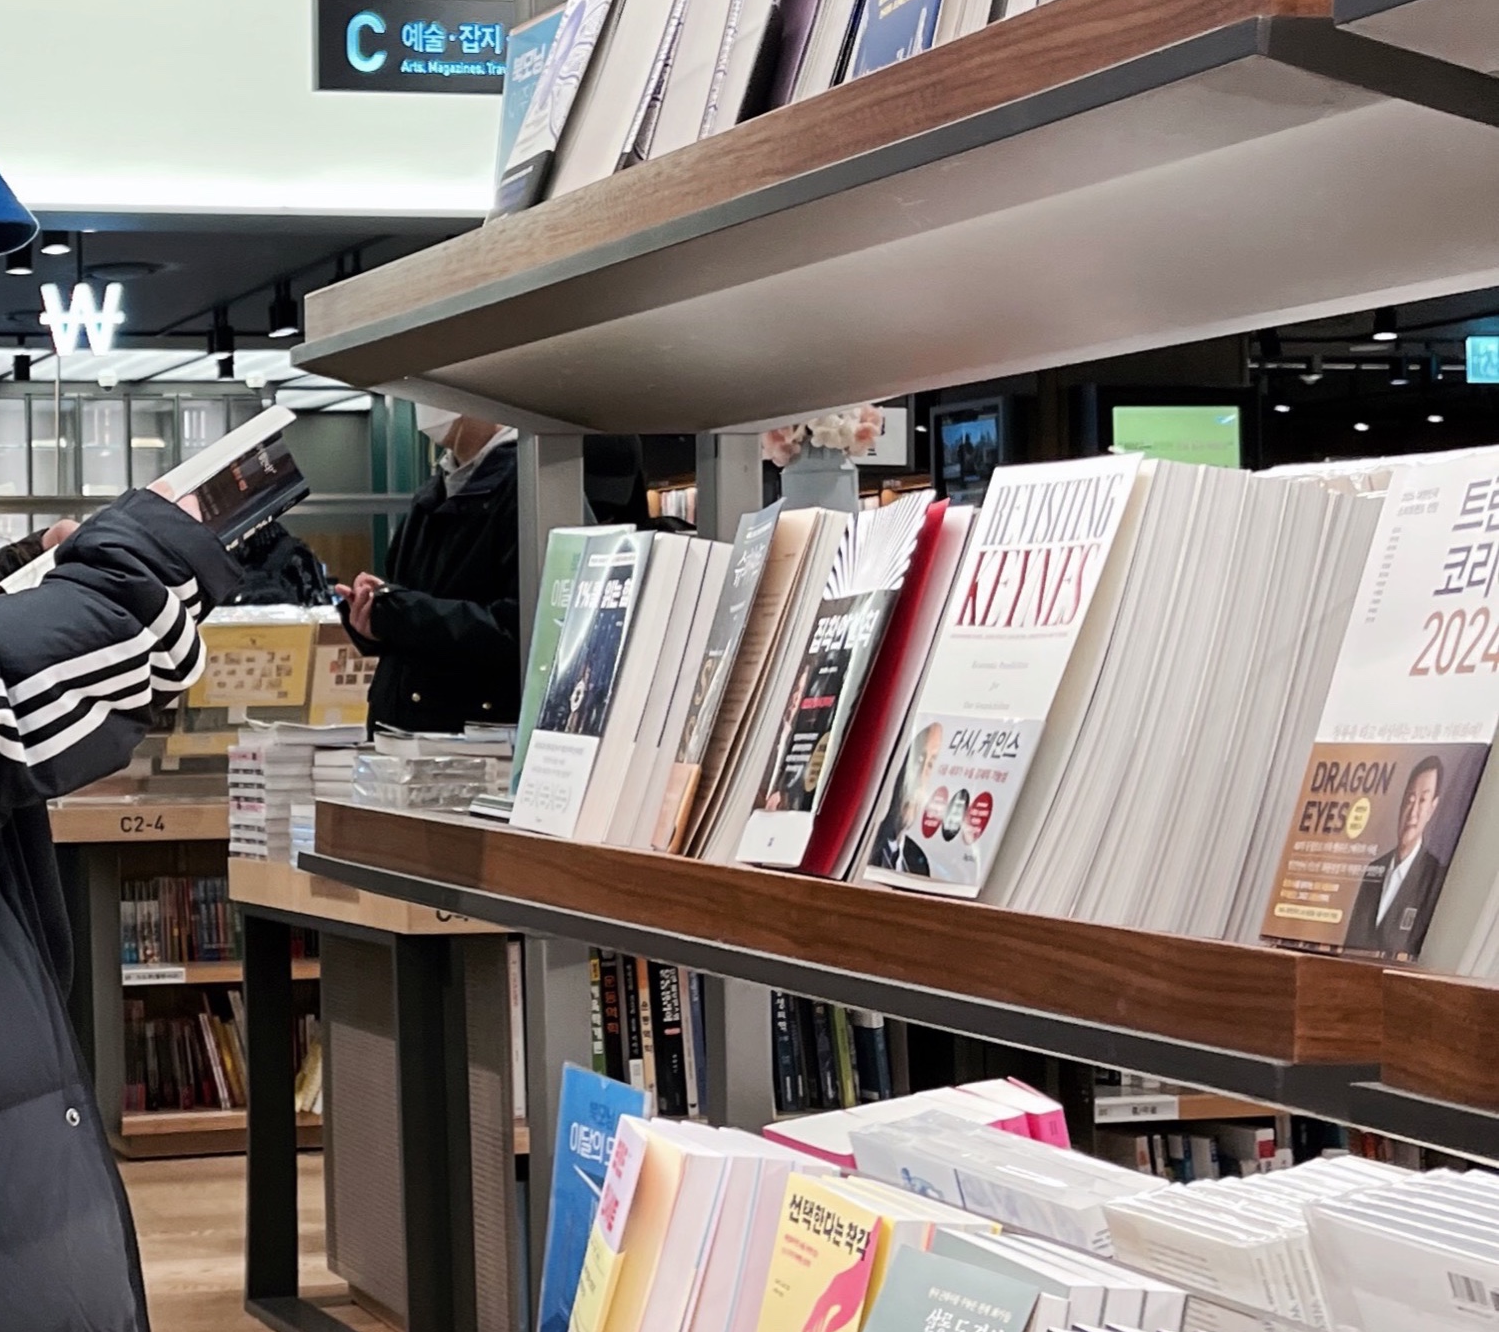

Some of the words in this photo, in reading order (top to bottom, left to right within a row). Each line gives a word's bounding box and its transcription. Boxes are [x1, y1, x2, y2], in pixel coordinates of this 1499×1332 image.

[345, 10, 388, 73] C
[981, 472, 1125, 547] REVISITING
[954, 542, 1101, 628] KEYNES
[1433, 541, 1499, 598] 코리
[1408, 605, 1499, 677] 2024
[949, 729, 981, 757] 다시,
[977, 730, 1022, 759] 케인스
[1310, 761, 1398, 795] DRAGON
[119, 815, 166, 833] C2-4
[1298, 800, 1351, 833] EYES
[569, 1121, 605, 1164] 이달의
[787, 1193, 846, 1249] 선택한다는
[844, 1222, 872, 1262] 착각
